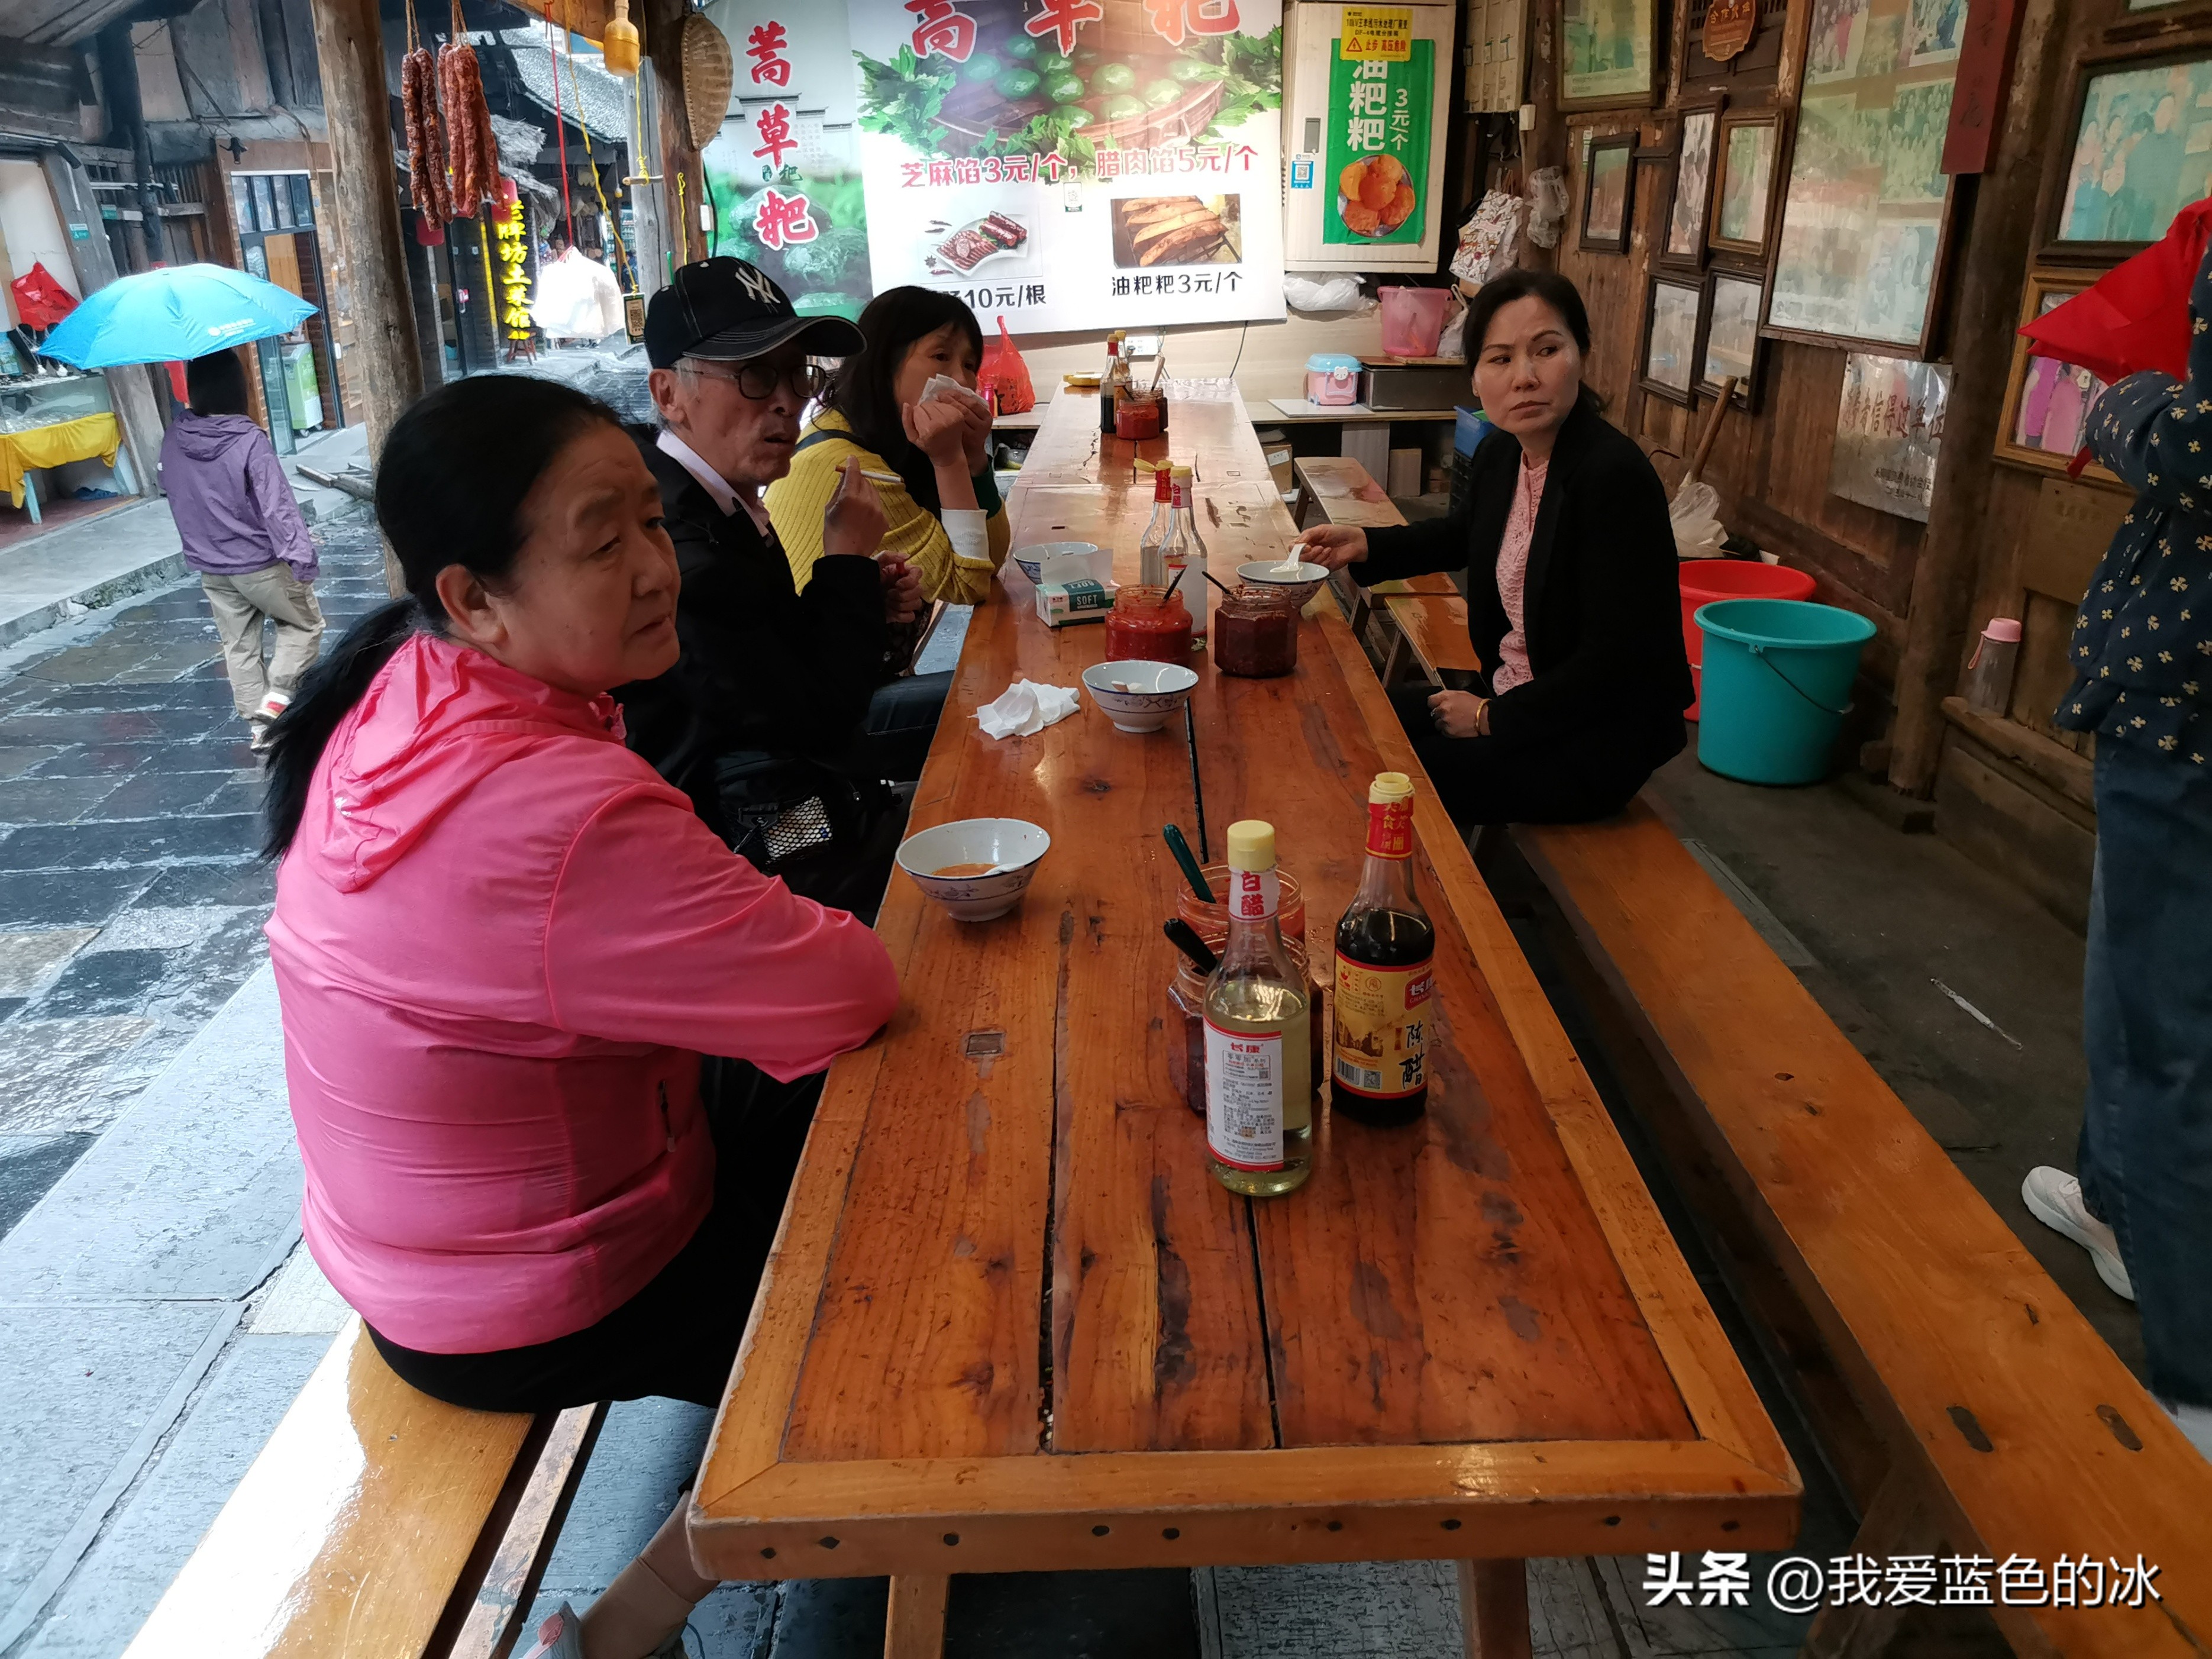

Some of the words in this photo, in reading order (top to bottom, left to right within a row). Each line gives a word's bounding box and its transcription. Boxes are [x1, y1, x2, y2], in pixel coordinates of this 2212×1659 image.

[1365, 39, 1378, 51] 止步
[1381, 40, 1406, 51] 高压危险
[1347, 60, 1388, 151] 油粑粑
[1389, 88, 1410, 151] 3元/个
[746, 21, 817, 247] 蒿草粑
[735, 267, 781, 304] NY
[1112, 270, 1243, 296] 油粑粑3元/个
[1076, 595, 1098, 605] SOFT
[1241, 871, 1264, 916] 白醋
[1231, 1042, 1260, 1054] 长康
[1399, 1018, 1425, 1089] 陈醋
